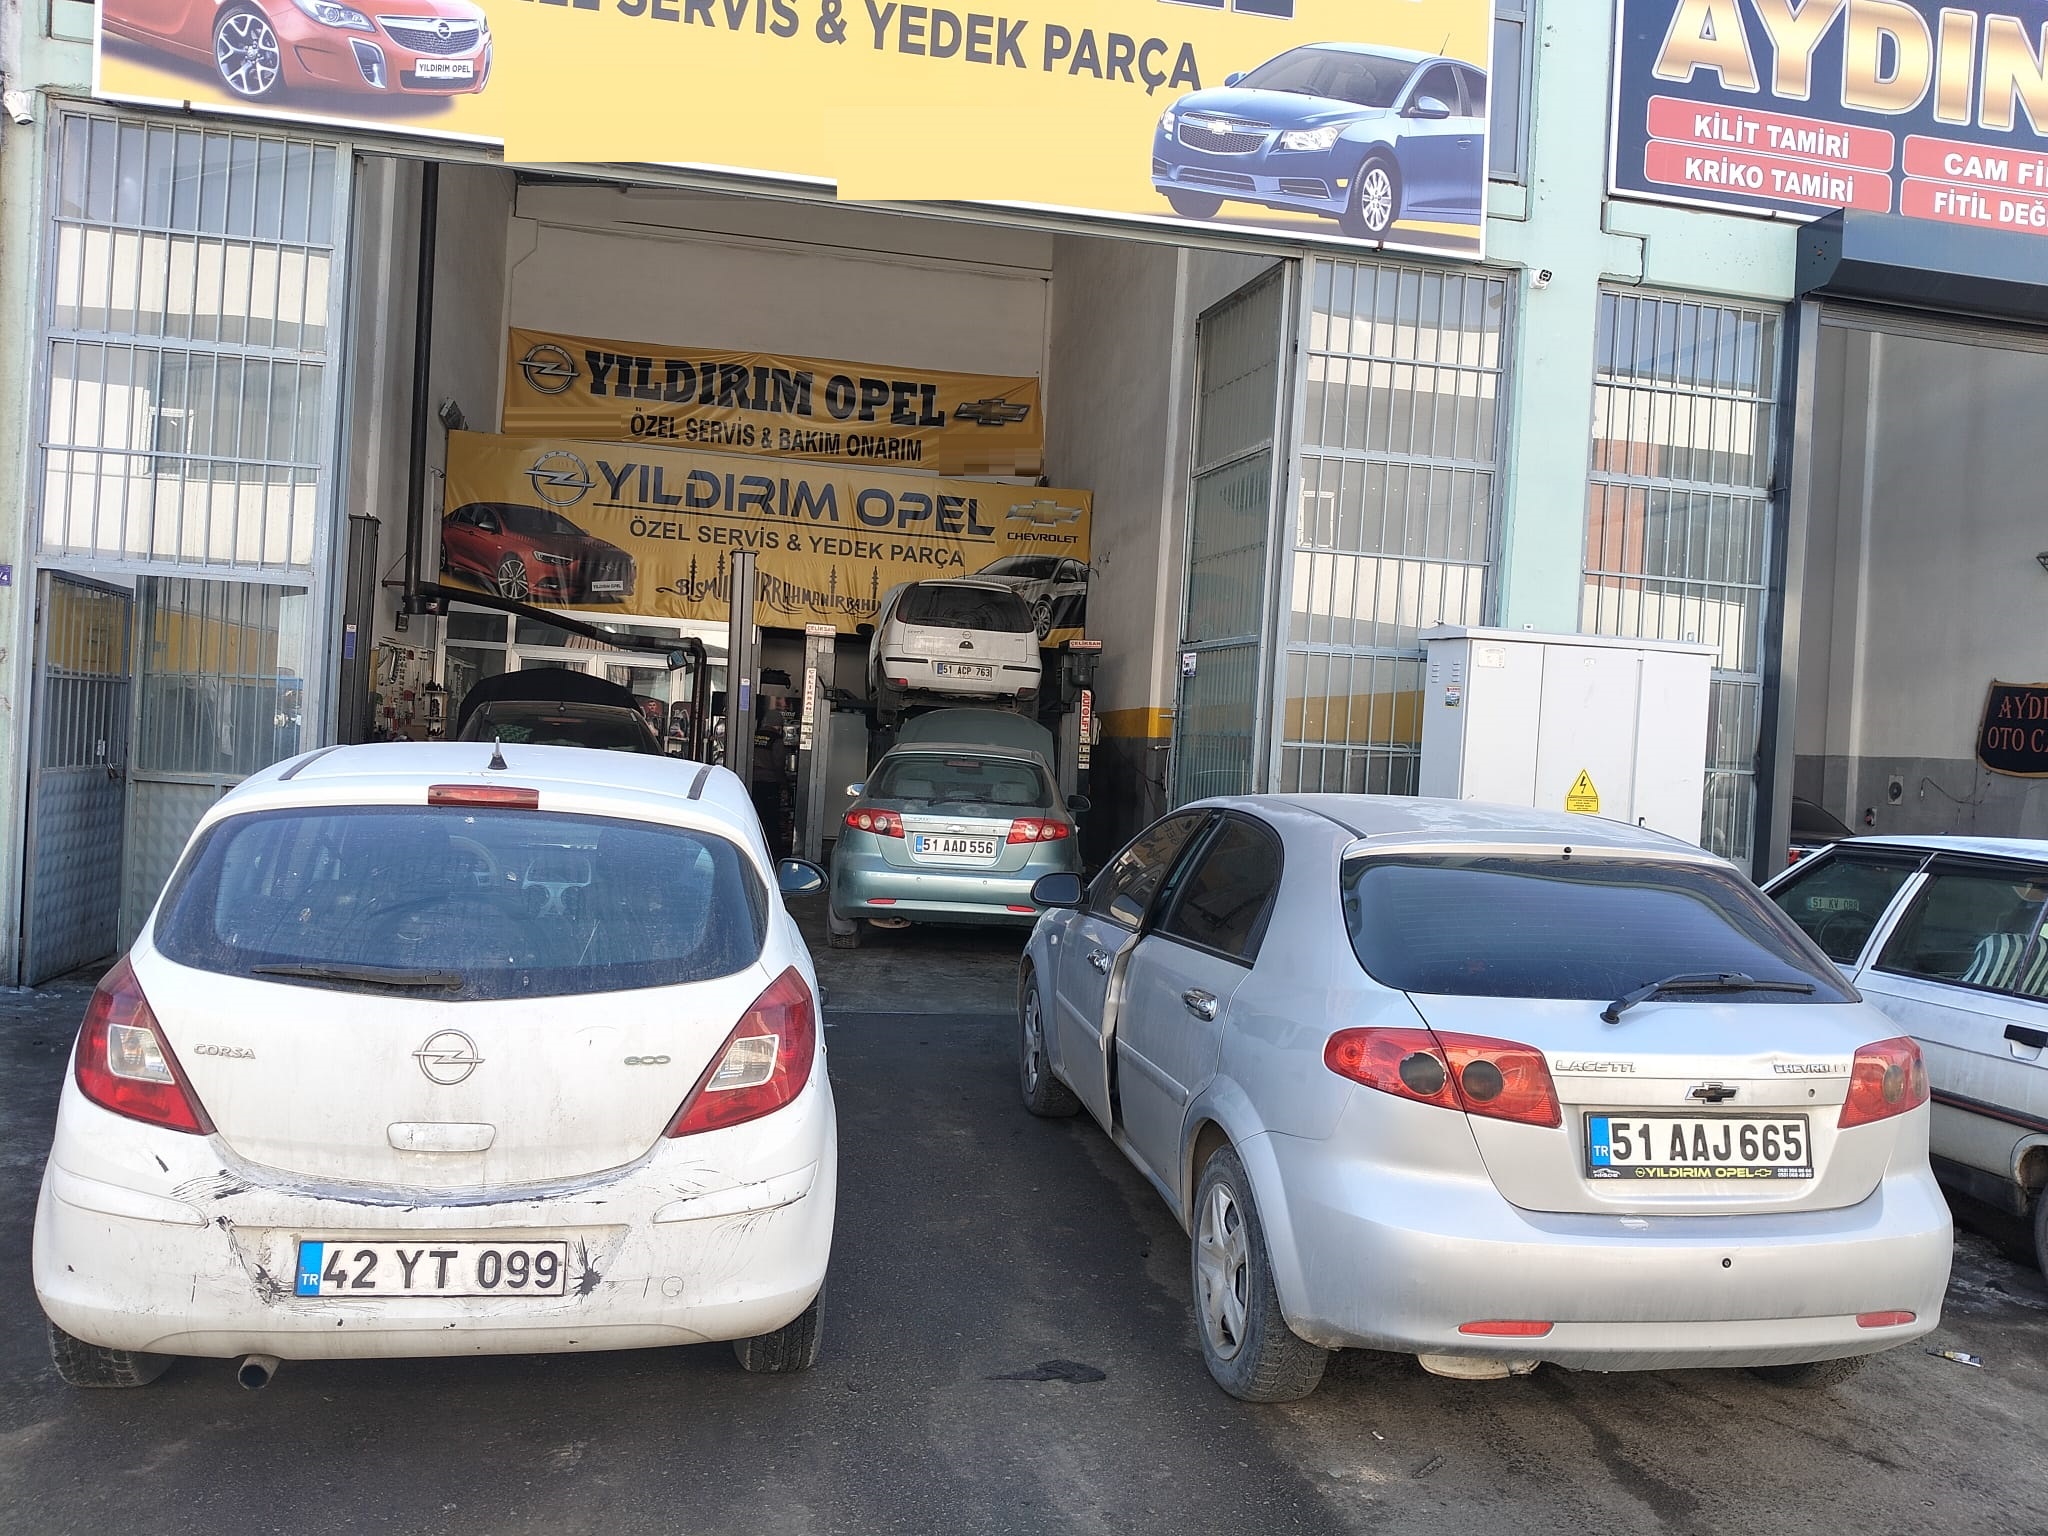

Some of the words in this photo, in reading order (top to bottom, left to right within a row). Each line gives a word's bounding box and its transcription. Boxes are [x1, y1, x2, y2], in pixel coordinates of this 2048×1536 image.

[816, 0, 848, 45] &
[865, 0, 1028, 68] YEDEK
[1043, 25, 1202, 97] PARÇA
[419, 64, 450, 72] YILDIRIM
[452, 65, 471, 73] OPEL
[1694, 112, 1760, 145] KİLİT
[1766, 124, 1849, 159] TAMİRİ
[1685, 156, 1764, 189] KRİKO
[1771, 168, 1854, 203] TAMİRİ
[1944, 153, 2009, 182] CAM
[2018, 160, 2048, 188] Fİ
[1934, 188, 1992, 220] FİTİL
[1999, 199, 2048, 228] DEĞ
[585, 349, 813, 417] YILDIRIM
[825, 375, 946, 428] OPEL
[630, 406, 680, 440] ÖZEL
[685, 416, 755, 447] SERVİS
[761, 427, 773, 449] &
[779, 428, 841, 455] BAKIM
[846, 434, 922, 462] ONARIM
[596, 460, 839, 522] YILDIRIM
[857, 488, 996, 536] OPEL
[630, 515, 691, 541] ÖZEL
[697, 526, 779, 549] SERVİS
[787, 533, 802, 551] &
[809, 535, 884, 561] YEDEK
[891, 544, 965, 569] PARÇA
[1007, 532, 1080, 544] CHEVROLET
[943, 665, 952, 674] 51
[957, 666, 972, 675] ACP
[976, 667, 990, 677] 763
[1081, 691, 1090, 733] AUTOLIFT
[1987, 726, 2025, 751] OTO
[2031, 728, 2048, 753] C
[923, 838, 938, 851] 51
[943, 839, 967, 853] AAD
[969, 841, 993, 854] 556
[193, 1043, 257, 1060] CORSA
[624, 1054, 671, 1066] eco
[1593, 1145, 1608, 1157] TR
[1612, 1123, 1652, 1161] 51
[1669, 1123, 1732, 1162] AAJ
[1740, 1124, 1801, 1162] 665
[1645, 1167, 1712, 1178] YILDIRIM
[1715, 1167, 1755, 1178] OPEL
[302, 1273, 319, 1286] TR
[323, 1250, 378, 1289] 42
[396, 1250, 458, 1289] YT
[477, 1250, 559, 1289] 099
